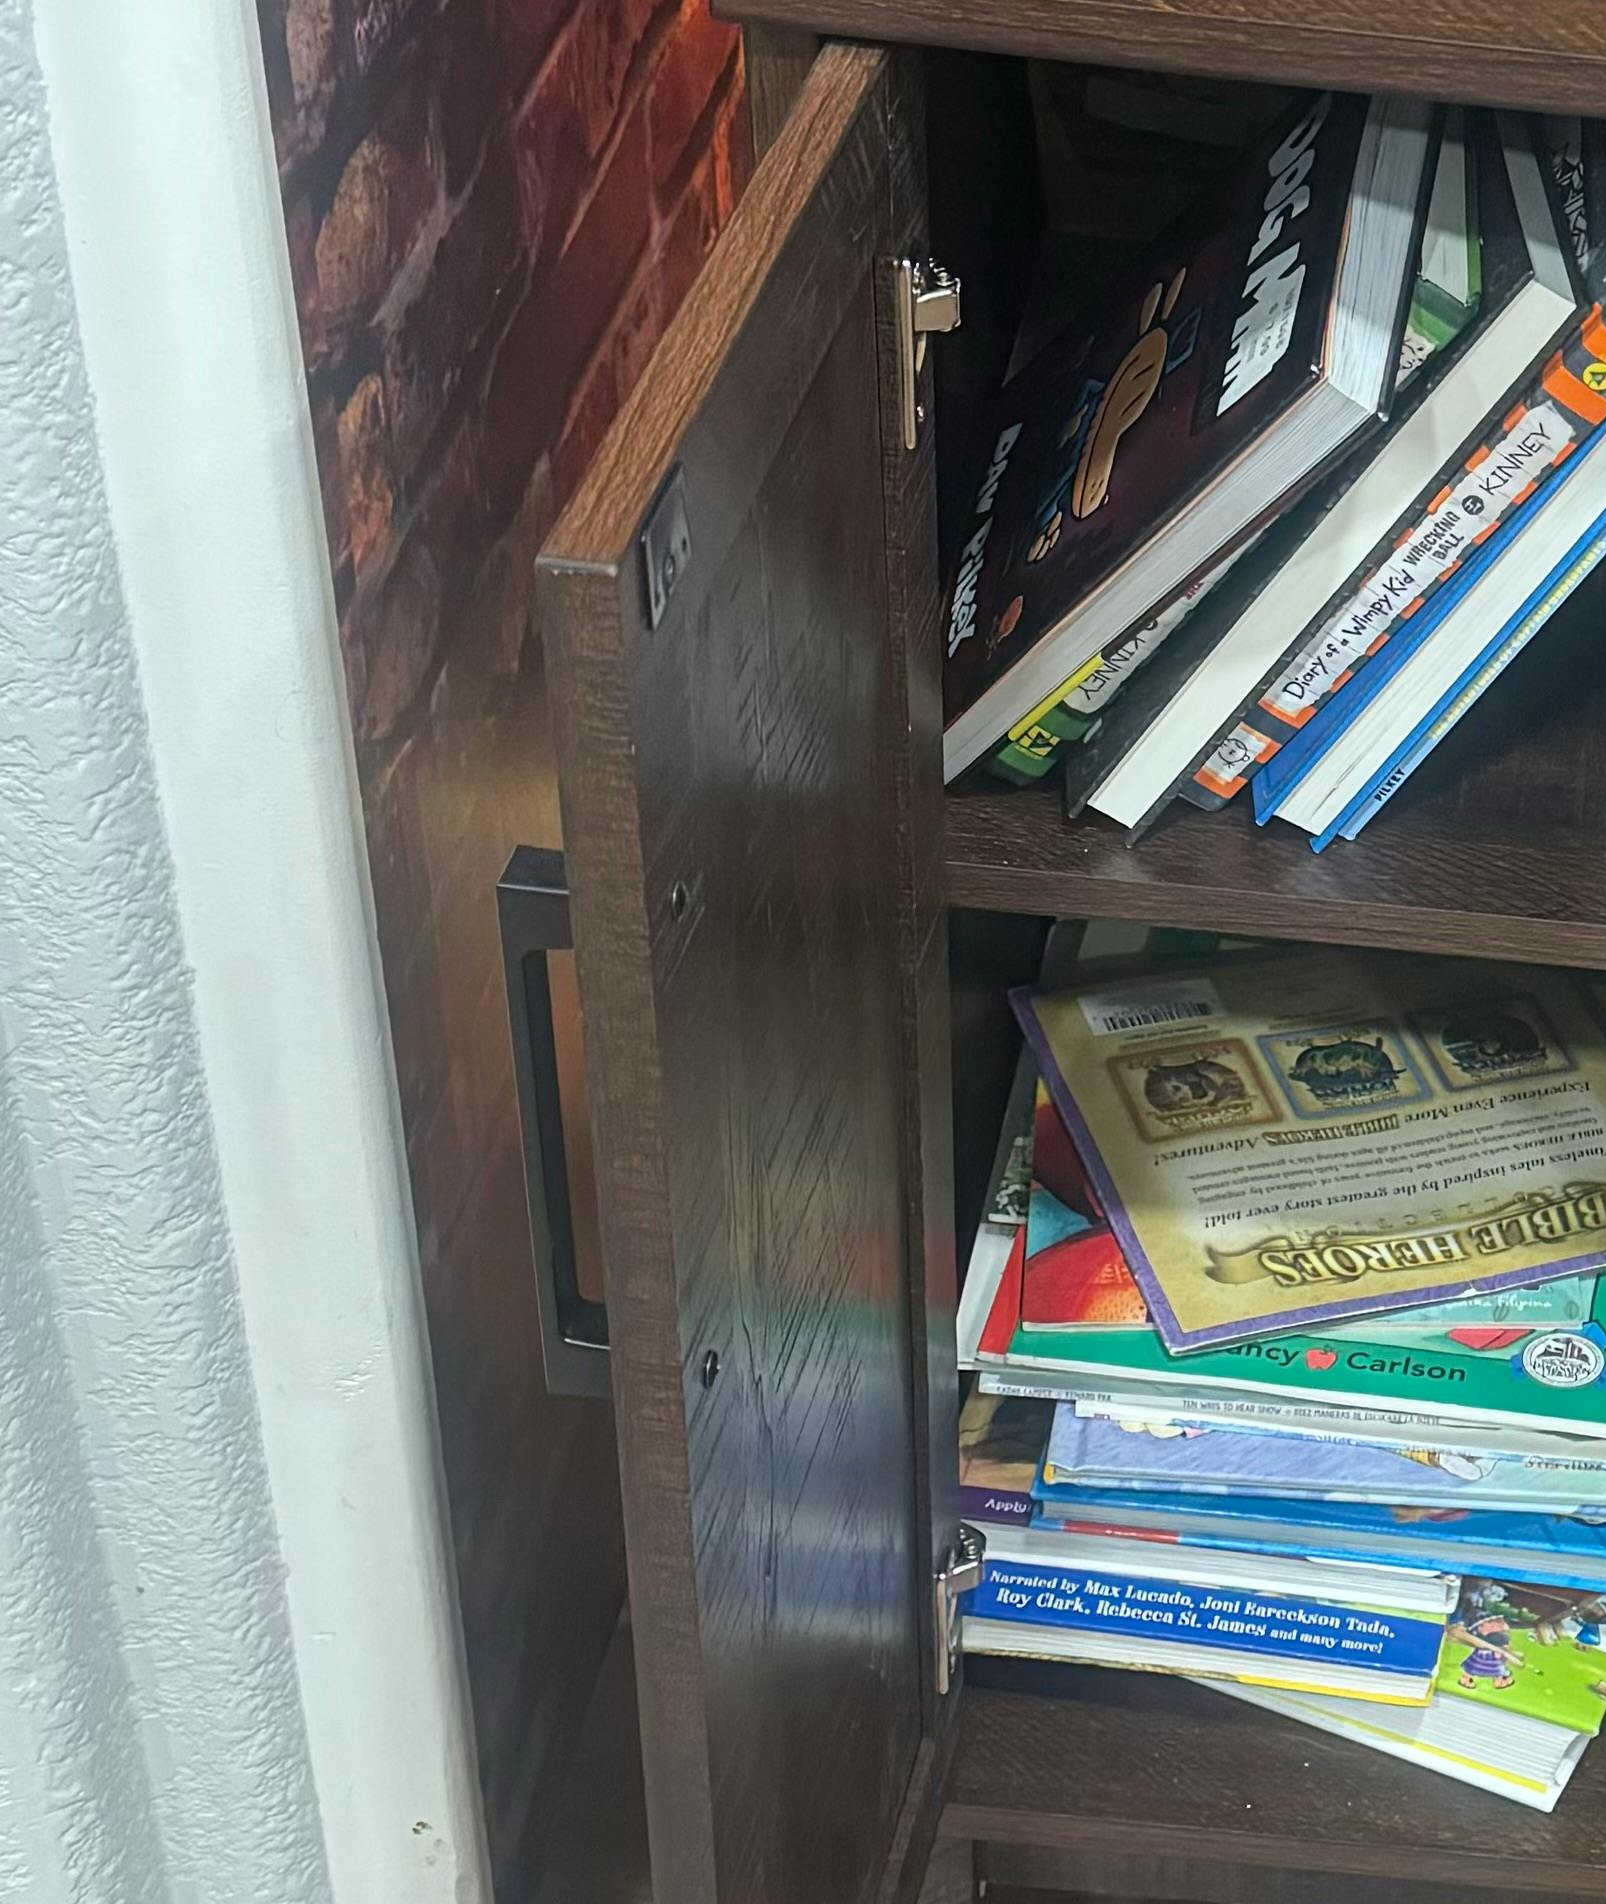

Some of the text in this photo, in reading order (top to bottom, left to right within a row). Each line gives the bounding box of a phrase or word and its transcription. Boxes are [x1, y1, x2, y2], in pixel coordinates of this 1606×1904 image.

[1282, 656, 1328, 699] Diary
[1326, 644, 1340, 657] of
[1342, 594, 1393, 635] Wimpy
[1382, 569, 1415, 596] Kid
[1403, 511, 1460, 565] WRECKING
[1432, 534, 1464, 560] BALL
[1479, 422, 1551, 495] KINNEY
[1374, 768, 1405, 801] PILKEY
[1454, 1096, 1495, 1112] Even
[1500, 1081, 1590, 1107] Experience
[1404, 1107, 1450, 1124] More
[1155, 1136, 1258, 1166] Adventures!
[1510, 1154, 1545, 1171] tales
[1421, 1178, 1439, 1193] by
[1444, 1162, 1506, 1188] inspired
[1328, 1185, 1388, 1206] greatest
[1393, 1184, 1417, 1196] the
[1246, 1205, 1280, 1218] ever
[1284, 1194, 1324, 1212] story
[1204, 1210, 1241, 1228] told!
[1260, 1230, 1470, 1286] HEROES
[1224, 1342, 1466, 1382] ancy Carlson
[989, 1570, 1058, 1589] Narrated
[1060, 1578, 1079, 1594] by
[1084, 1579, 1120, 1598] Max
[1125, 1585, 1194, 1608] Lucado,
[1200, 1596, 1240, 1614] Joni
[1244, 1602, 1340, 1629] Eareckson
[996, 1588, 1032, 1609] Roy
[1096, 1600, 1173, 1624] Rebecca
[1177, 1612, 1201, 1628] St.
[1207, 1616, 1266, 1637] James
[1269, 1627, 1298, 1641] and
[1299, 1632, 1338, 1648] many
[1341, 1638, 1383, 1654] more!
